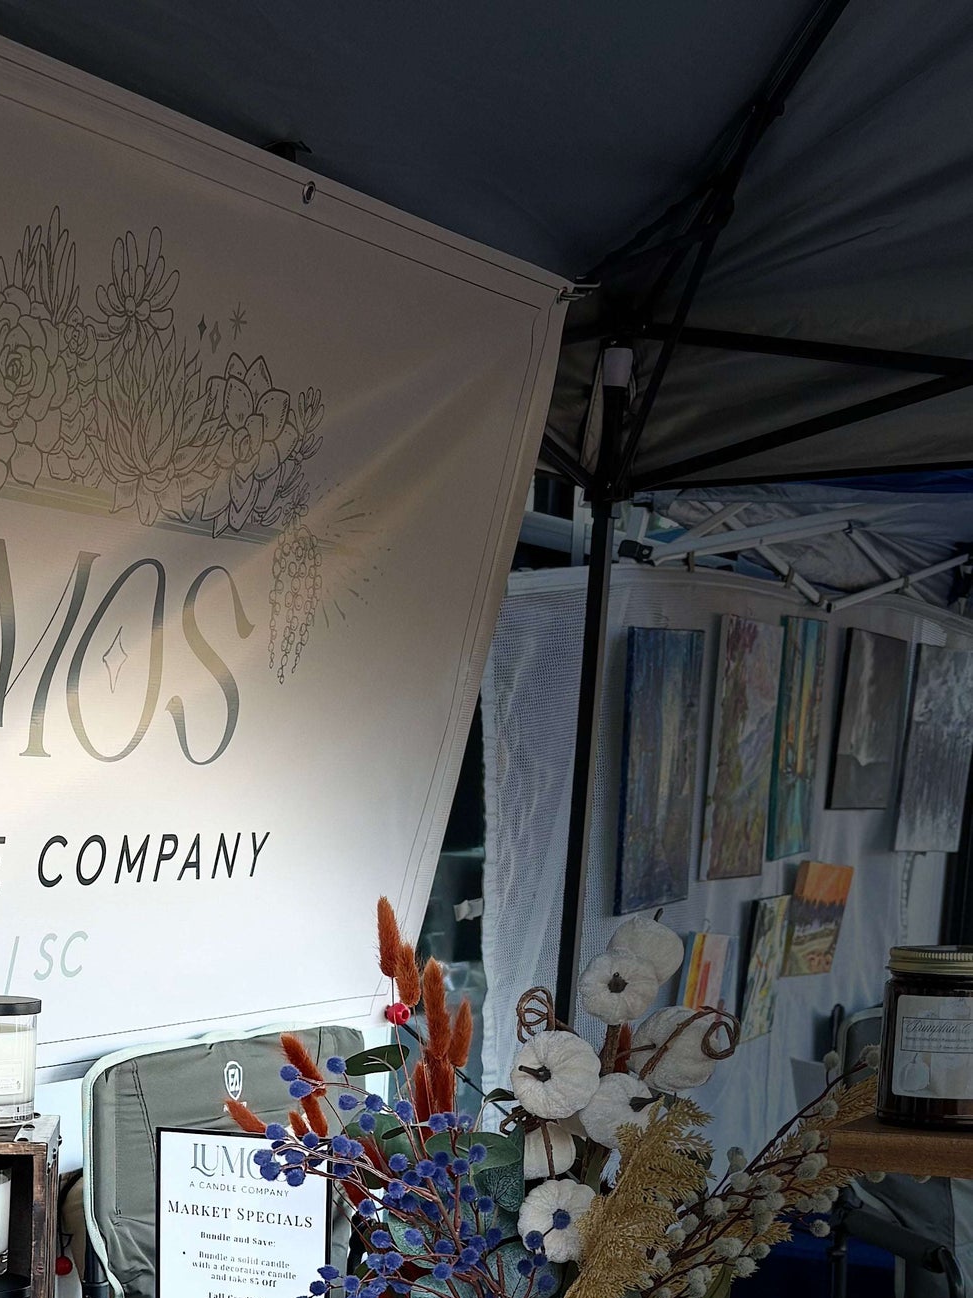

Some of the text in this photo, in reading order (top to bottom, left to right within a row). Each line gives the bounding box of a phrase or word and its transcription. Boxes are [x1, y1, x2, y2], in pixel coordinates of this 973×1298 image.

[36, 830, 271, 889] COMPANY
[32, 929, 90, 982] SC
[199, 1181, 237, 1192] CANDLE
[241, 1185, 289, 1197] COMPANY
[168, 1200, 313, 1228] MARKET SPECIALS
[200, 1232, 231, 1241] Bundle
[199, 1251, 228, 1261] Bundle
[238, 1256, 259, 1265] solid
[261, 1259, 290, 1269] candle
[192, 1261, 210, 1269] with
[220, 1263, 265, 1275] decorative
[268, 1270, 297, 1280] candle
[211, 1273, 226, 1281] and
[229, 1275, 247, 1284] take
[262, 1279, 277, 1287] Off
